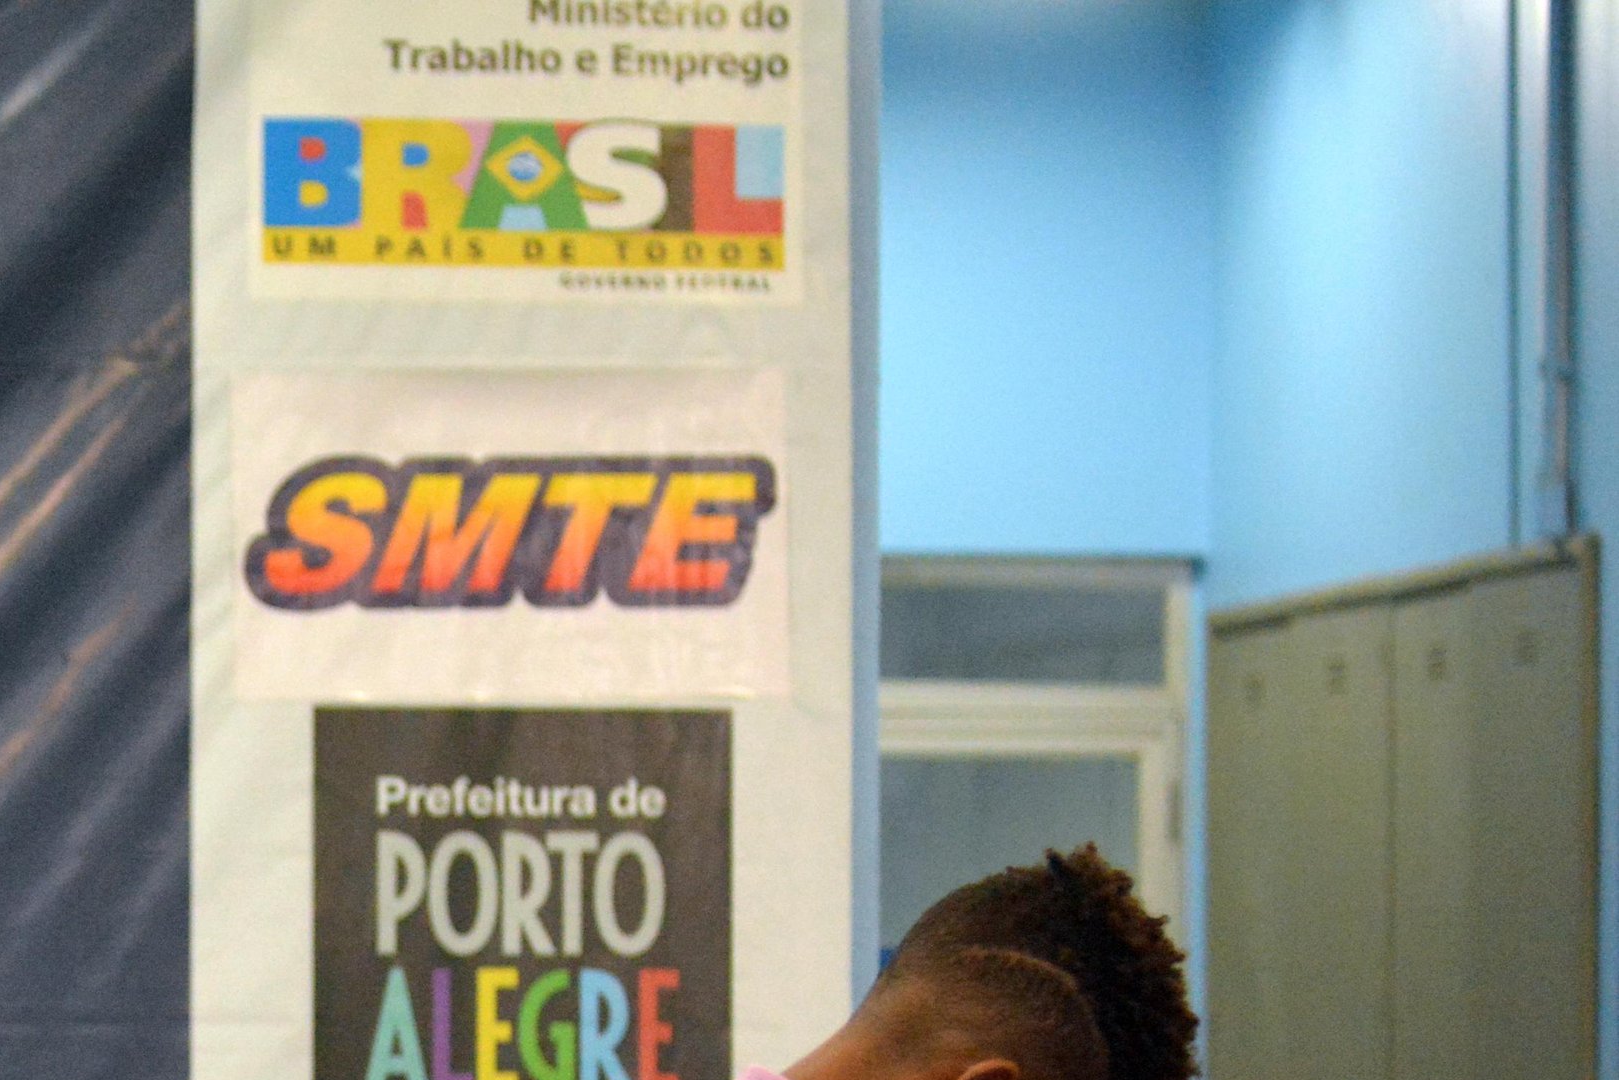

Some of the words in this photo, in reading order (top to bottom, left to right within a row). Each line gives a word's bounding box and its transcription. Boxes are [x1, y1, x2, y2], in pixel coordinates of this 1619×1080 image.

[527, 0, 728, 28] Ministério
[740, 0, 791, 29] do
[383, 38, 563, 74] Trabalho
[574, 48, 598, 74] e
[611, 43, 790, 84] Emprego
[263, 116, 784, 234] BRASIL
[272, 234, 336, 259] UM
[523, 236, 577, 265] DE
[614, 238, 776, 267] TODOS
[262, 470, 757, 595] SMTE
[375, 775, 597, 819] Prefeitura
[609, 778, 667, 819] de
[375, 830, 667, 957] PORTO
